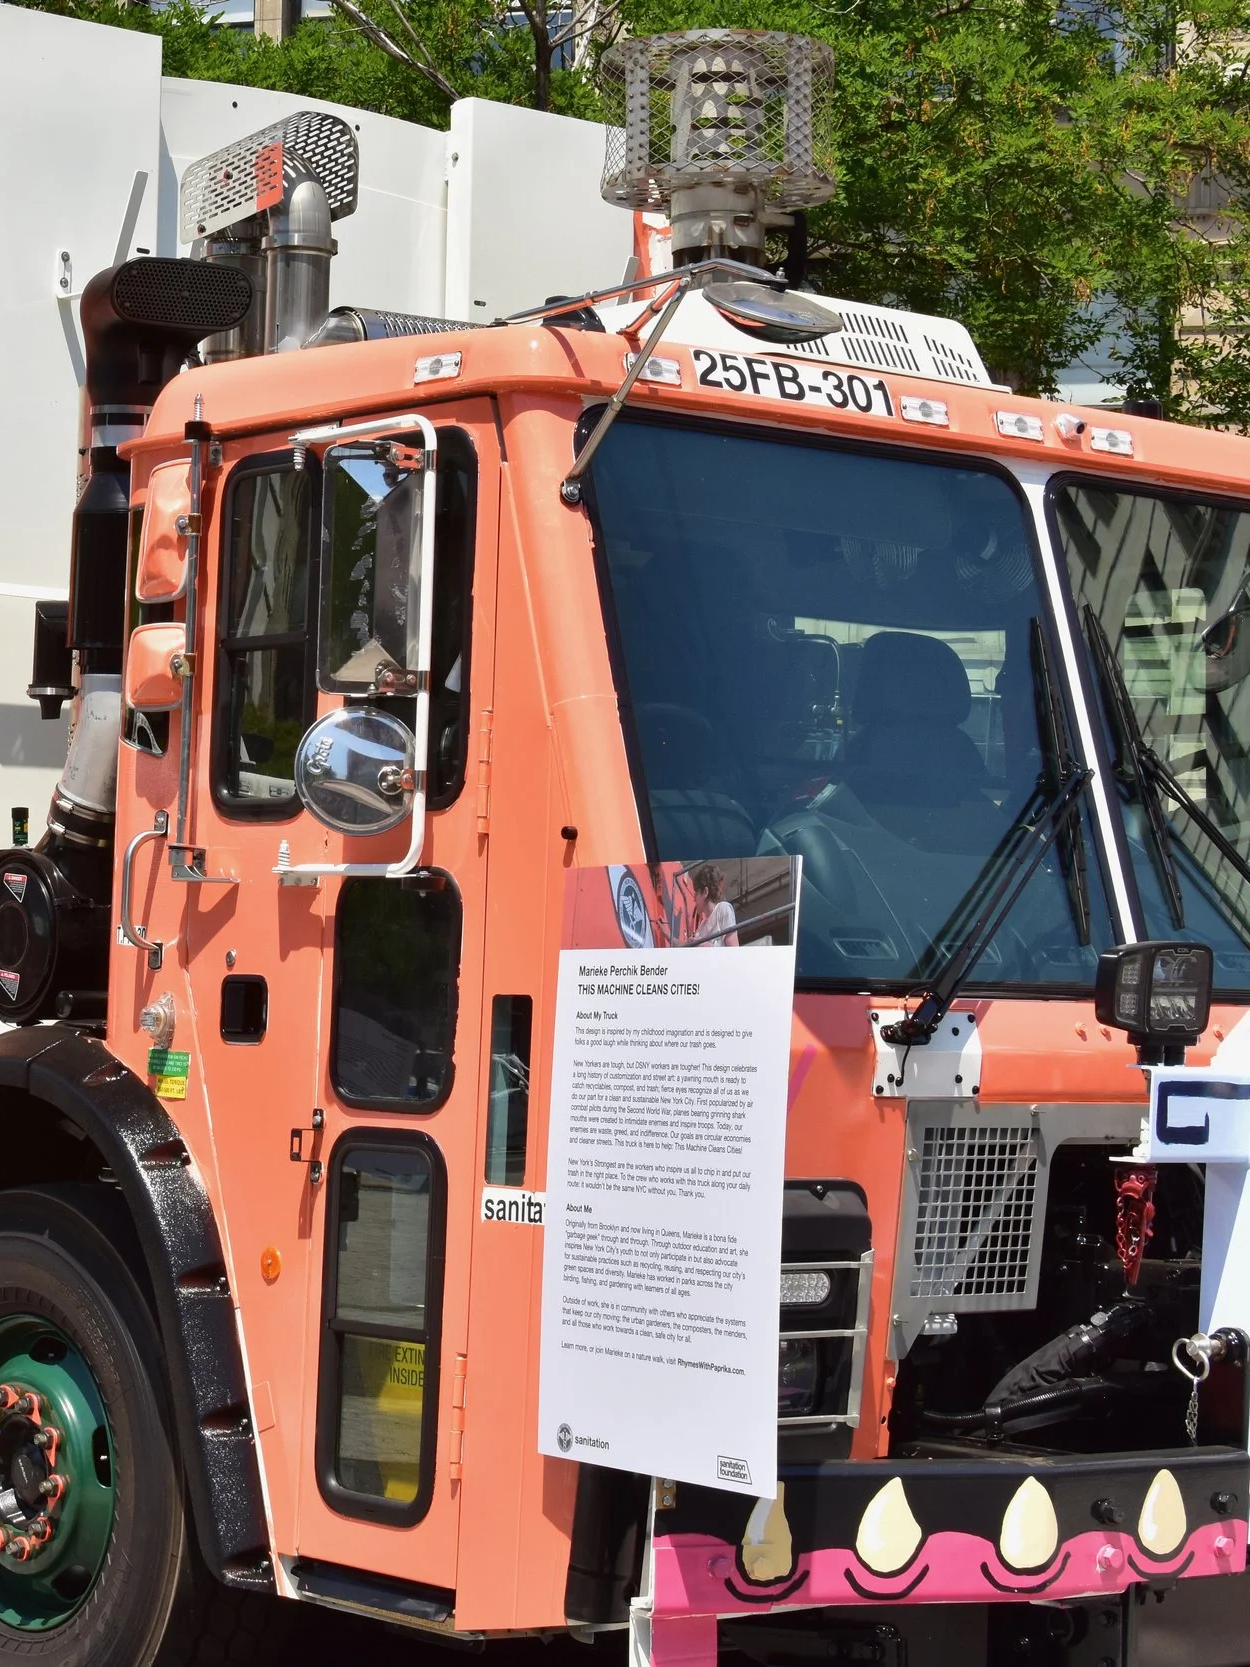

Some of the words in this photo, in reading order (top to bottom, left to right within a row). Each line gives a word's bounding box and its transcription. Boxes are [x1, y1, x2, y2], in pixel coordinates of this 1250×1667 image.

[693, 350, 894, 417] 25FB-301
[579, 965, 608, 976] Marieke
[609, 965, 637, 976] Perchik
[640, 964, 668, 976] Bender
[577, 984, 595, 994] THIS
[597, 983, 633, 994] MACHINE
[635, 983, 668, 995] CLEANS
[670, 983, 699, 995] CITIES!
[575, 1011, 592, 1019] About
[593, 1011, 601, 1020] My
[602, 1011, 618, 1019] Truck
[575, 1026, 584, 1034] This
[585, 1027, 600, 1036] design
[606, 1027, 625, 1036] inspired
[625, 1028, 631, 1037] by
[632, 1029, 640, 1037] my
[641, 1027, 664, 1036] childhood
[665, 1029, 693, 1038] imagination
[710, 1029, 734, 1038] designed
[741, 1030, 752, 1039] give
[570, 1103, 588, 1111] combat
[588, 1103, 601, 1113] pilots
[602, 1105, 617, 1114] during
[626, 1105, 645, 1114] Second
[645, 1106, 660, 1115] World
[660, 1107, 672, 1116] War,
[673, 1108, 689, 1117] planes
[690, 1109, 709, 1119] bearing
[710, 1110, 731, 1120] grinning
[731, 1111, 745, 1119] shark
[484, 1195, 546, 1223] sanita
[565, 1203, 582, 1212] About
[583, 1204, 592, 1213] Me
[571, 1252, 597, 1262] sustainable
[597, 1256, 619, 1266] practices
[620, 1258, 632, 1267] such
[639, 1260, 663, 1272] recycling,
[663, 1264, 683, 1274] reusing,
[684, 1265, 694, 1274] and
[694, 1267, 721, 1278] respecting
[731, 1270, 745, 1281] city's
[561, 1340, 574, 1349] Learn
[574, 1344, 588, 1352] more,
[594, 1345, 603, 1355] join
[604, 1347, 623, 1357] Marieke
[635, 1352, 651, 1361] nature
[652, 1354, 665, 1364] walk,
[665, 1356, 676, 1365] visit
[677, 1357, 745, 1377] RhymesWithPaprika.com.
[389, 1366, 424, 1387] INSIDE
[575, 1434, 609, 1450] sanitation
[719, 1460, 745, 1472] sanitation
[719, 1467, 748, 1480] foundation
